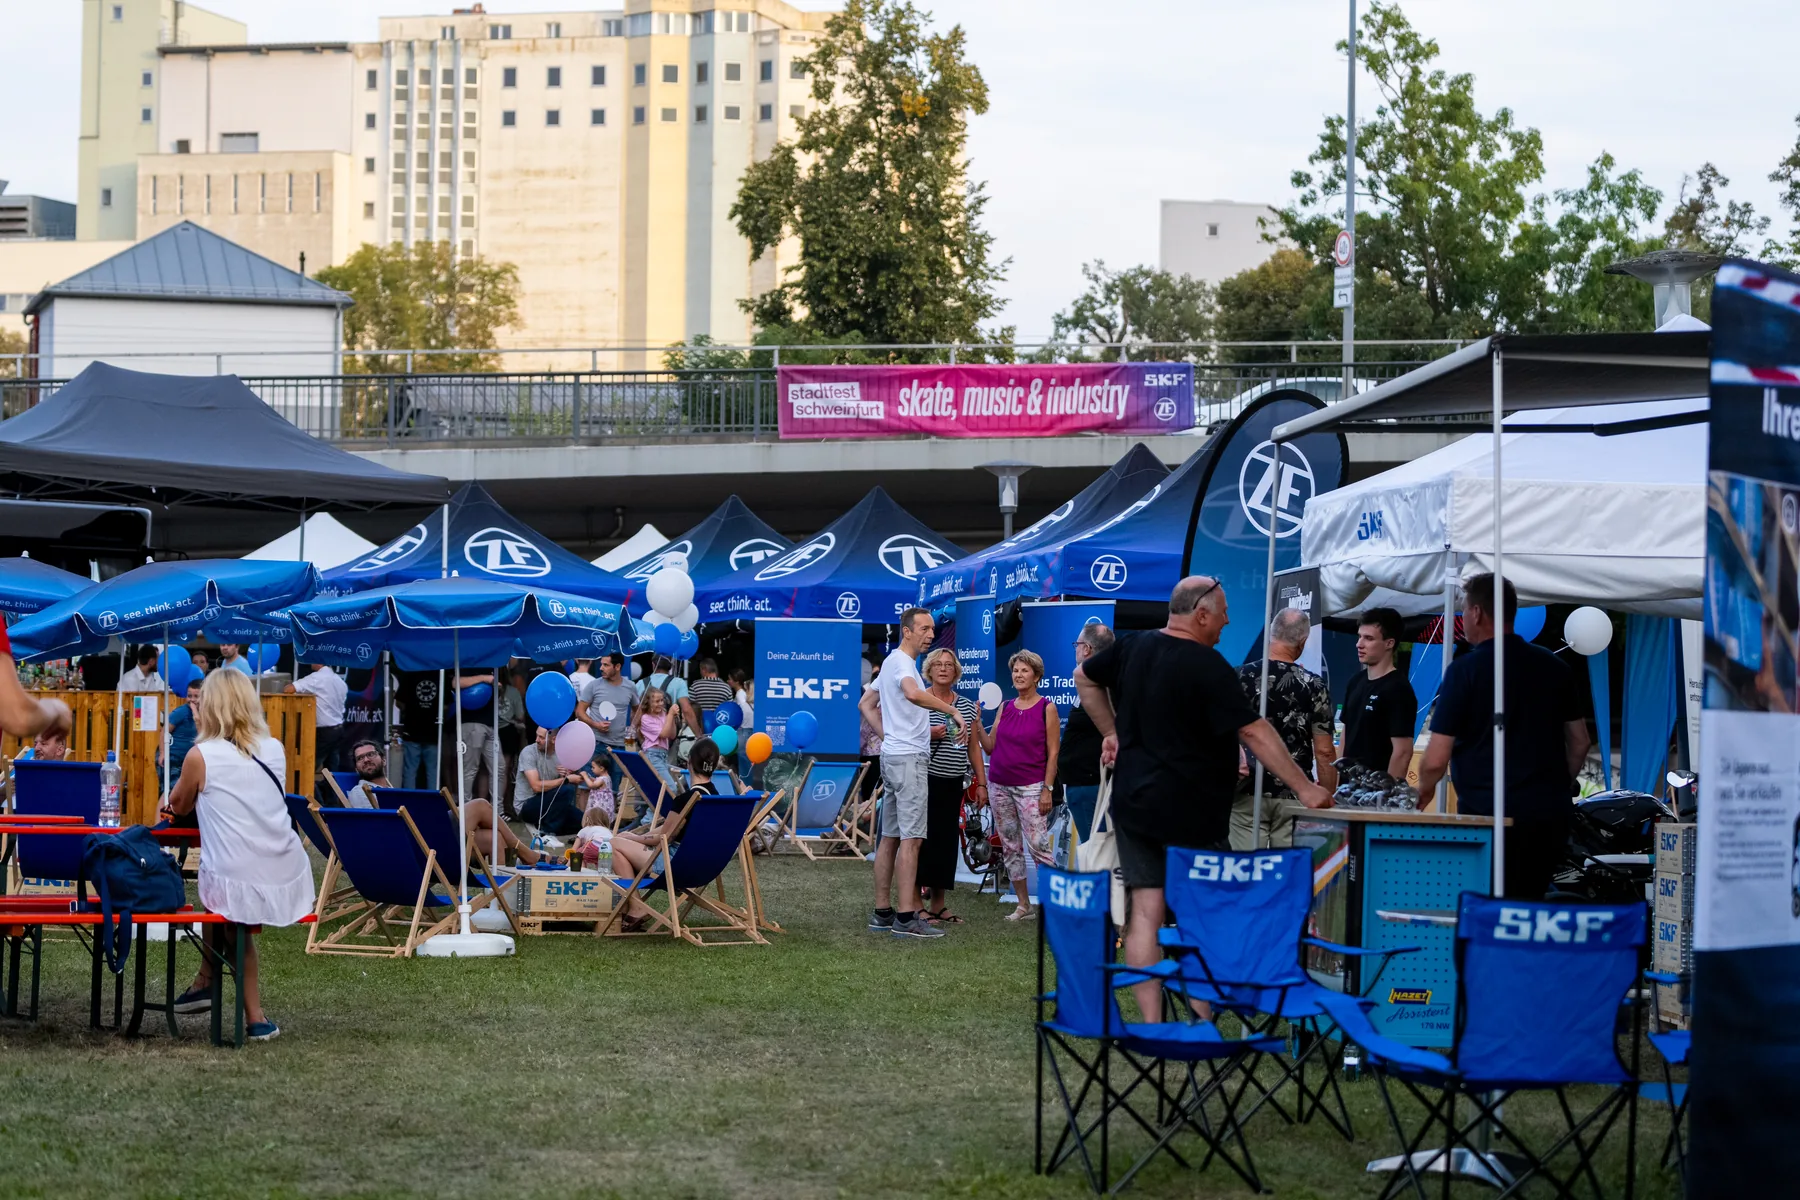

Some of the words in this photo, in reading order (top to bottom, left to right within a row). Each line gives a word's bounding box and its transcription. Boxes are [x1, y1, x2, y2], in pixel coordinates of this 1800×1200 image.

[1144, 374, 1186, 386] SKF
[791, 385, 856, 399] stadtfest
[898, 379, 957, 420] skate,
[962, 378, 1024, 416] music
[1026, 378, 1043, 415] &
[1046, 378, 1130, 420] industry
[796, 402, 880, 419] schweinfurt
[1154, 398, 1176, 419] ZF
[1243, 449, 1314, 529] ZF
[352, 532, 425, 571] ZF
[464, 533, 551, 575] ZF
[757, 538, 833, 577] ZF
[1091, 558, 1127, 588] ZF
[98, 612, 119, 630] ZF
[124, 611, 144, 620] see.
[145, 602, 174, 615] think.
[176, 598, 194, 607] act.
[549, 600, 566, 617] ZF
[569, 606, 584, 614] see.
[709, 601, 726, 613] see.
[727, 595, 752, 611] think.
[754, 598, 772, 611] act.
[837, 594, 860, 616] ZF
[325, 615, 341, 623] see.
[341, 611, 364, 621] think.
[982, 612, 992, 631] ZF
[767, 651, 789, 660] Deine
[791, 652, 820, 660] Zukunft
[958, 648, 988, 660] Veränderung
[960, 663, 980, 674] edeutet
[1038, 678, 1050, 688] us
[1052, 676, 1075, 688] Trad
[716, 711, 729, 724] ZF
[1661, 833, 1678, 851] SKF
[1189, 855, 1283, 882] SKF
[546, 881, 598, 896] SKF
[1050, 875, 1094, 909] SKF
[1660, 878, 1677, 897] SKF
[1494, 907, 1615, 943] SKF
[1659, 922, 1677, 943] SKF
[1393, 991, 1427, 1001] HAZET
[1386, 1006, 1450, 1023] Assistent
